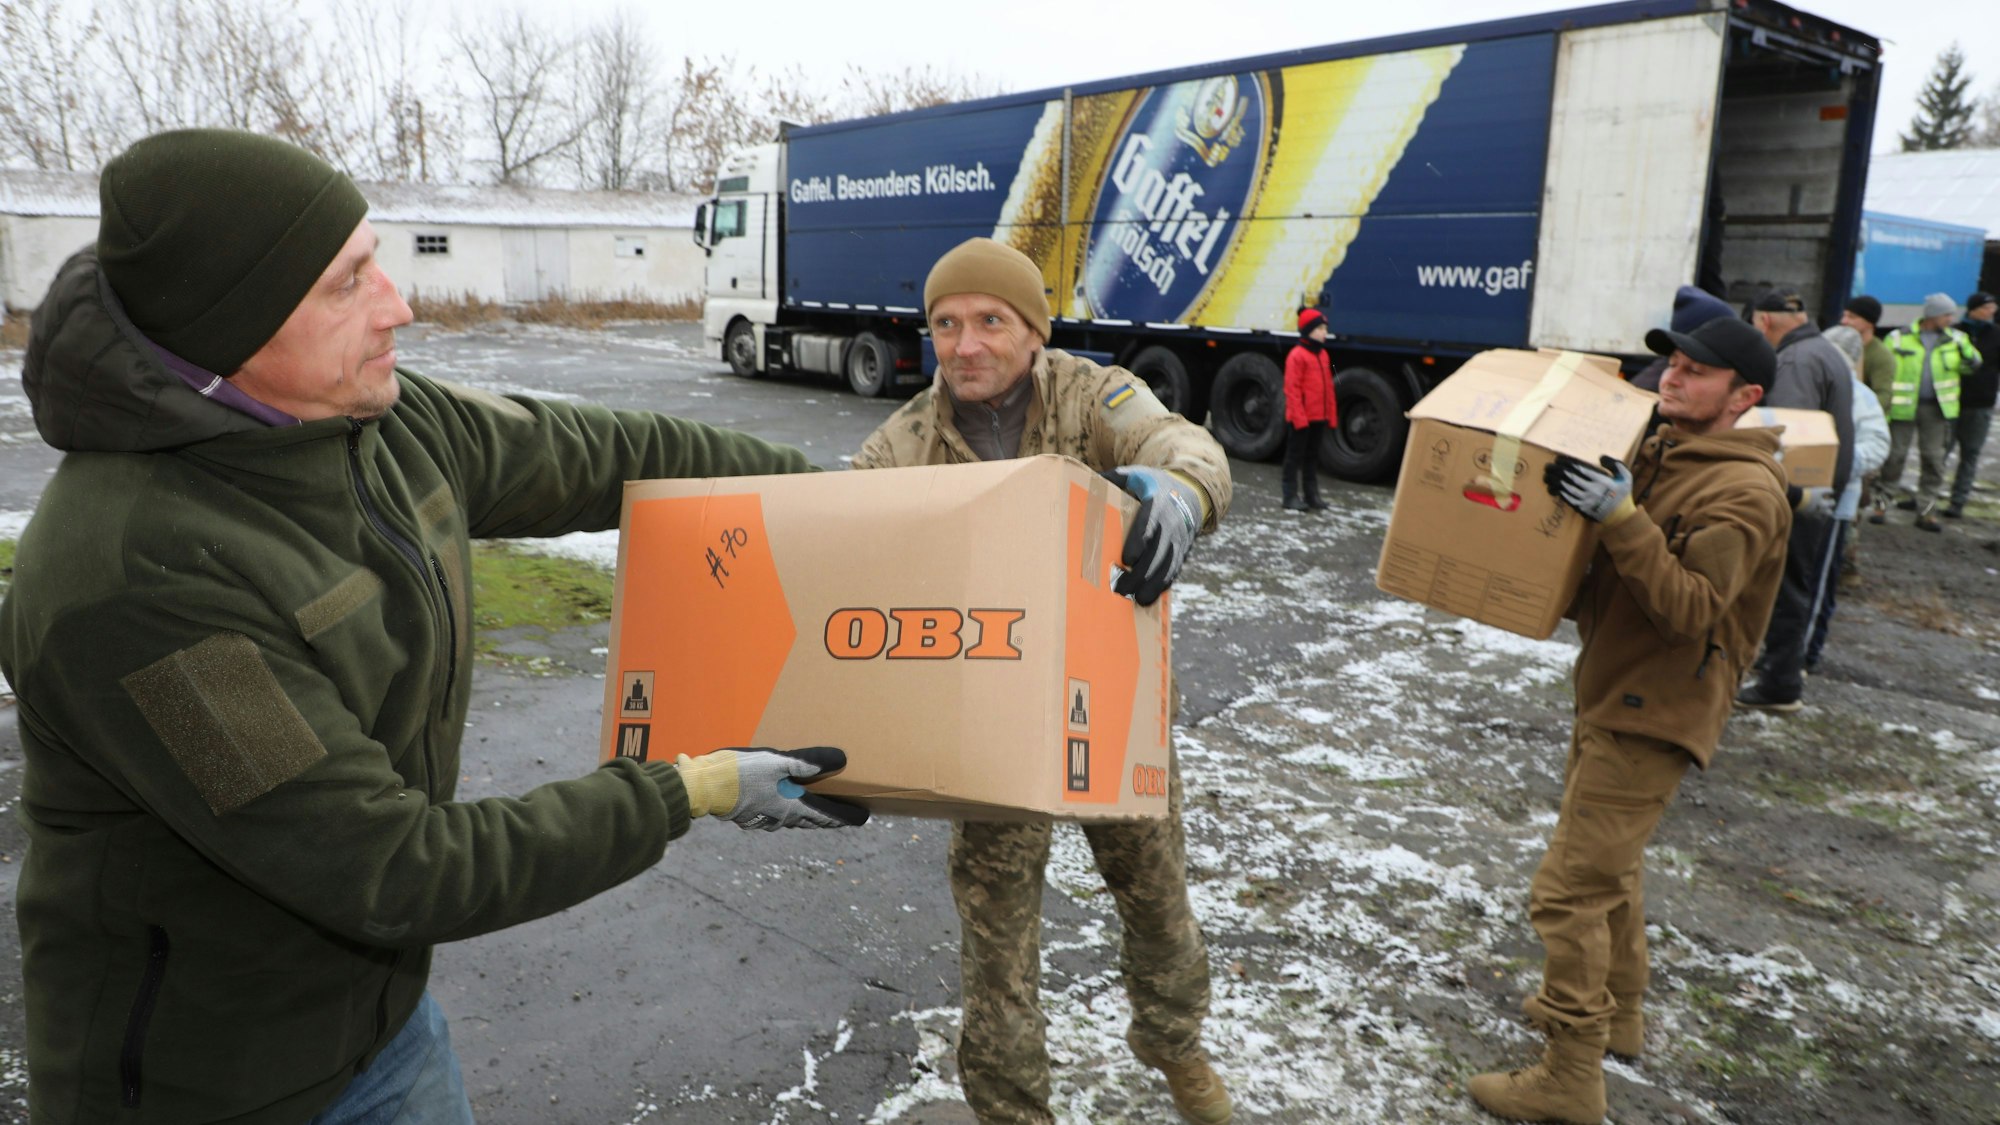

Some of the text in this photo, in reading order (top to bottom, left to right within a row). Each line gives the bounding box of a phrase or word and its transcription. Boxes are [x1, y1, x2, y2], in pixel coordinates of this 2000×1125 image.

[790, 161, 996, 204] Gaffel. Besonders Kölsch.
[1112, 132, 1231, 276] Gaffel
[1110, 208, 1177, 296] Kölsch
[1417, 259, 1533, 296] www.gaf
[824, 606, 1026, 660] OBI
[622, 727, 644, 757] M
[1072, 741, 1085, 777] M
[1132, 762, 1167, 797] OBI
